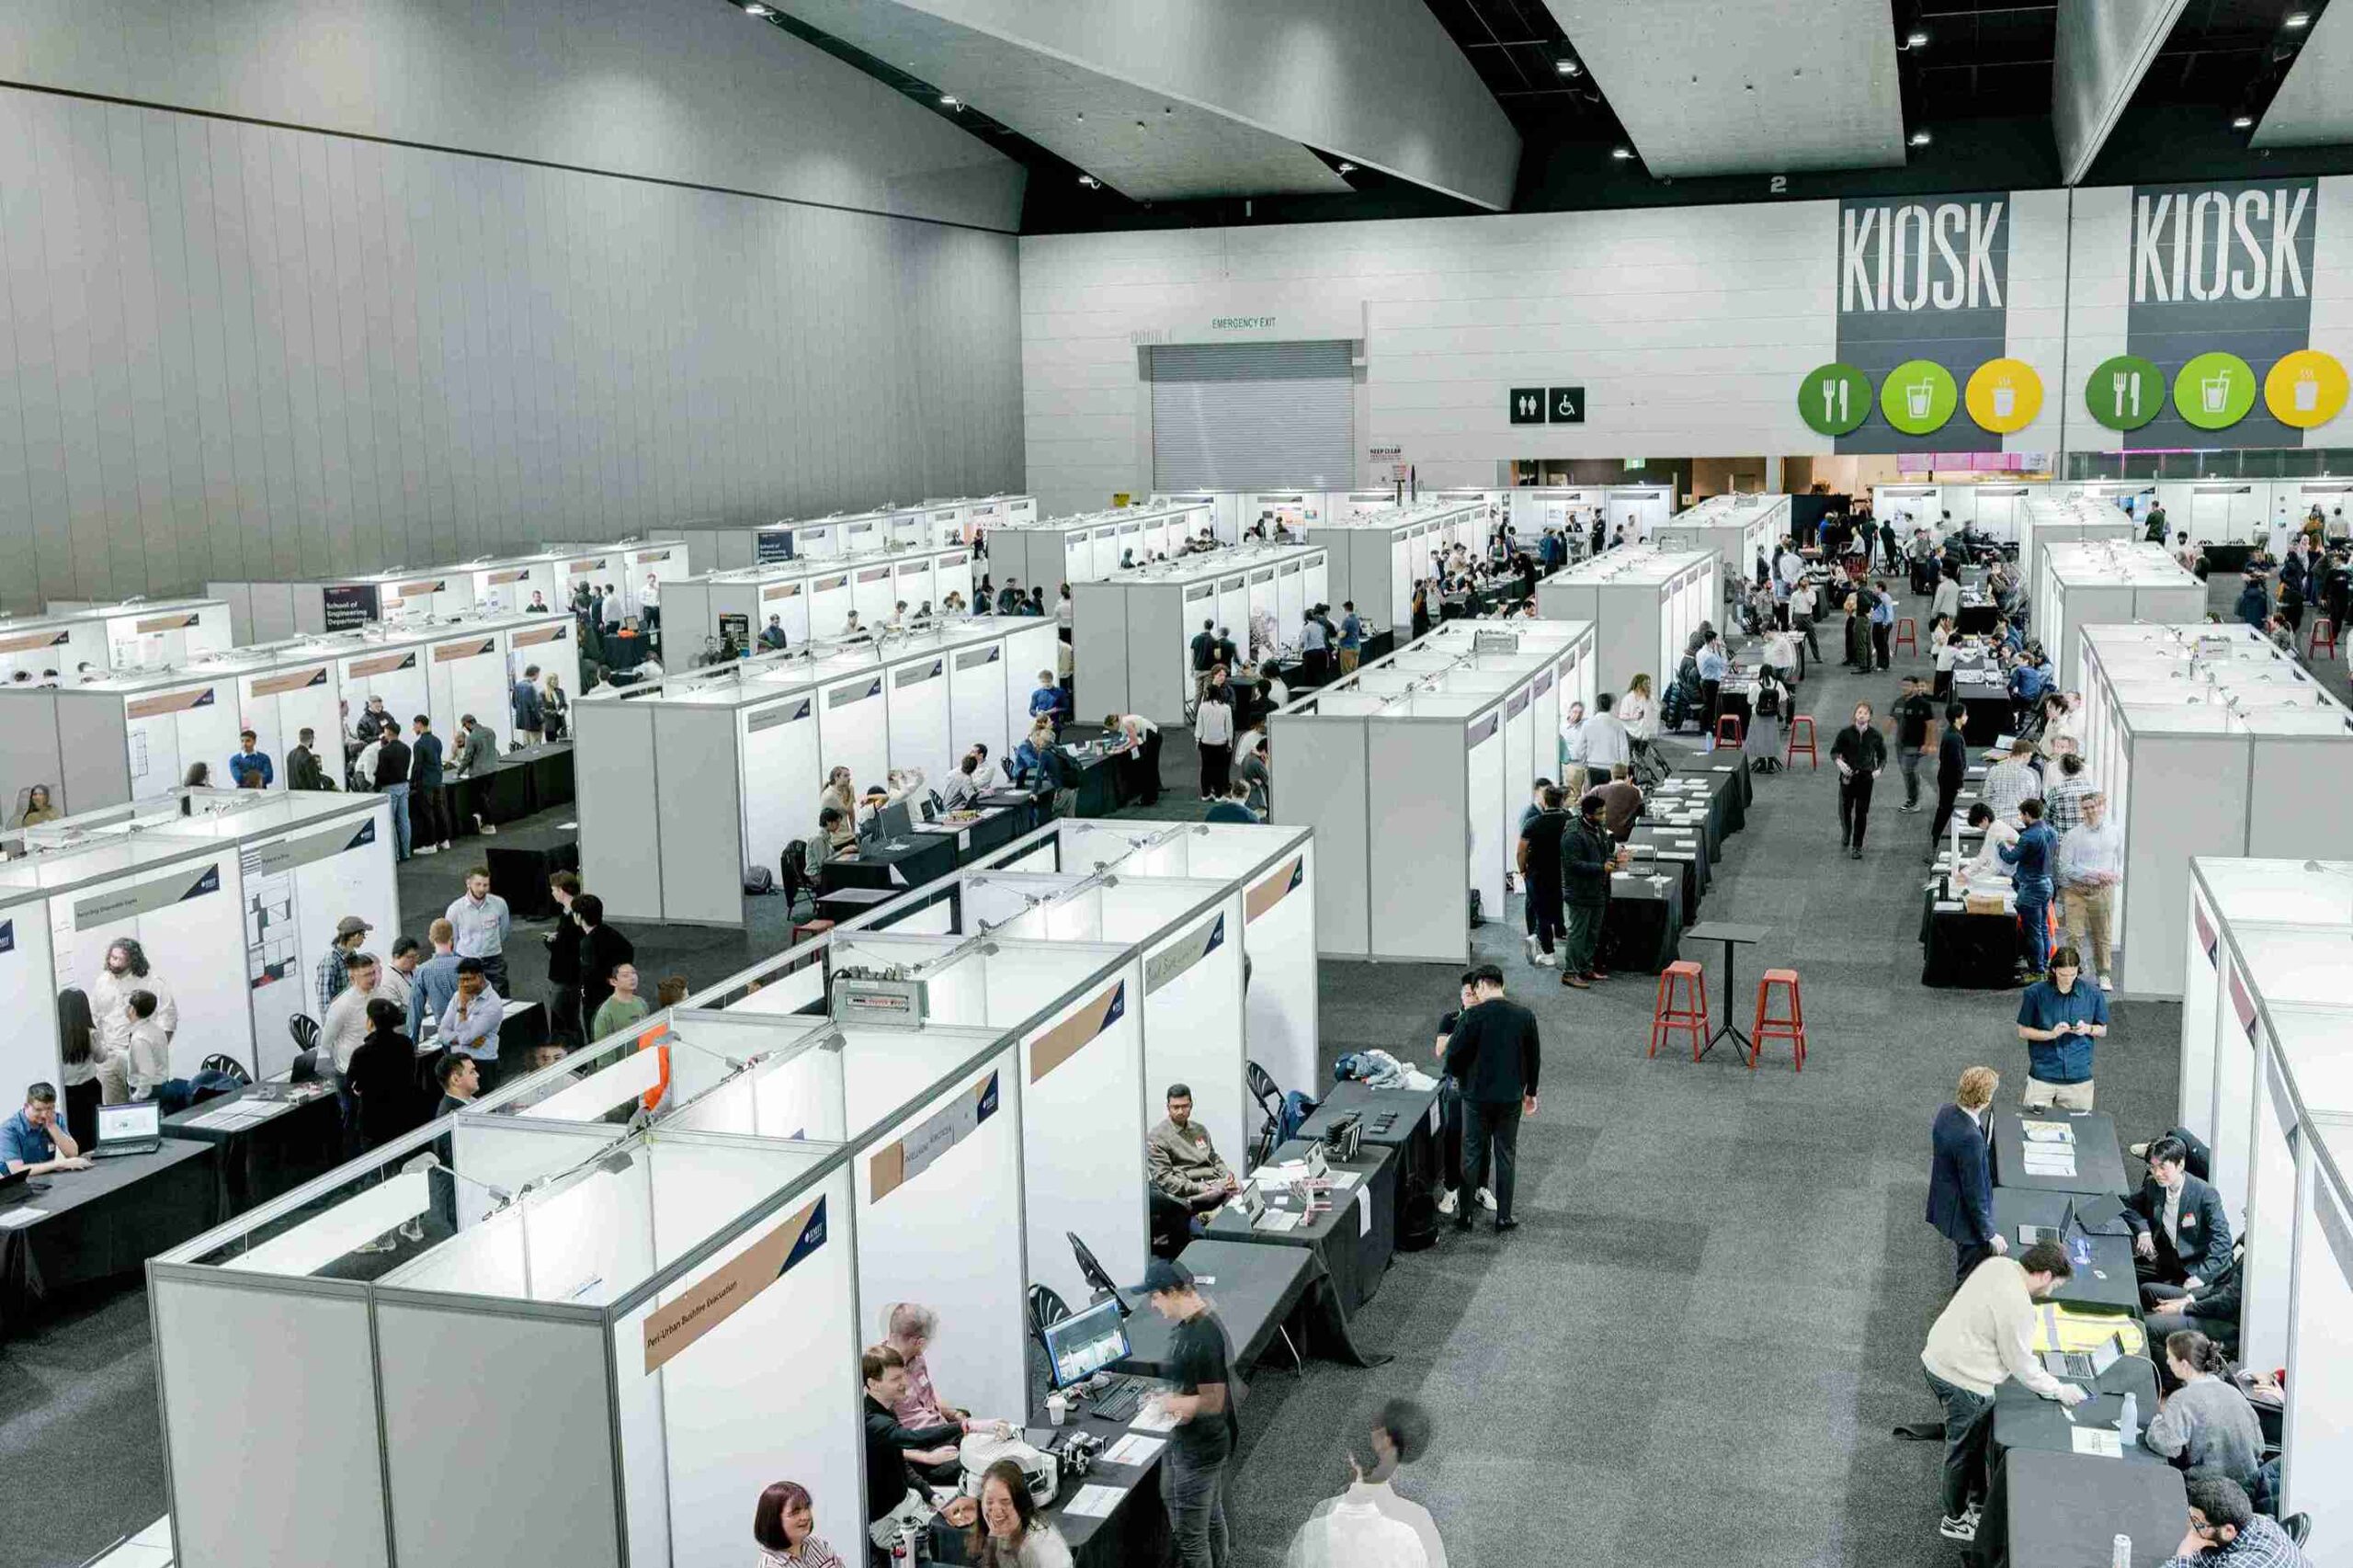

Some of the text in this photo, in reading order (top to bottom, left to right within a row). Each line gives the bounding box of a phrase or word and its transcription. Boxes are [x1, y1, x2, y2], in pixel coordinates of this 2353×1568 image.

[1770, 176, 1787, 193] 2
[1842, 201, 2004, 312] KIOSK
[2134, 187, 2311, 302] KIOSK
[1211, 317, 1276, 329] EMERGENCY EXIT
[647, 1280, 738, 1348] Peri-Urban Bushfire Evacuation
